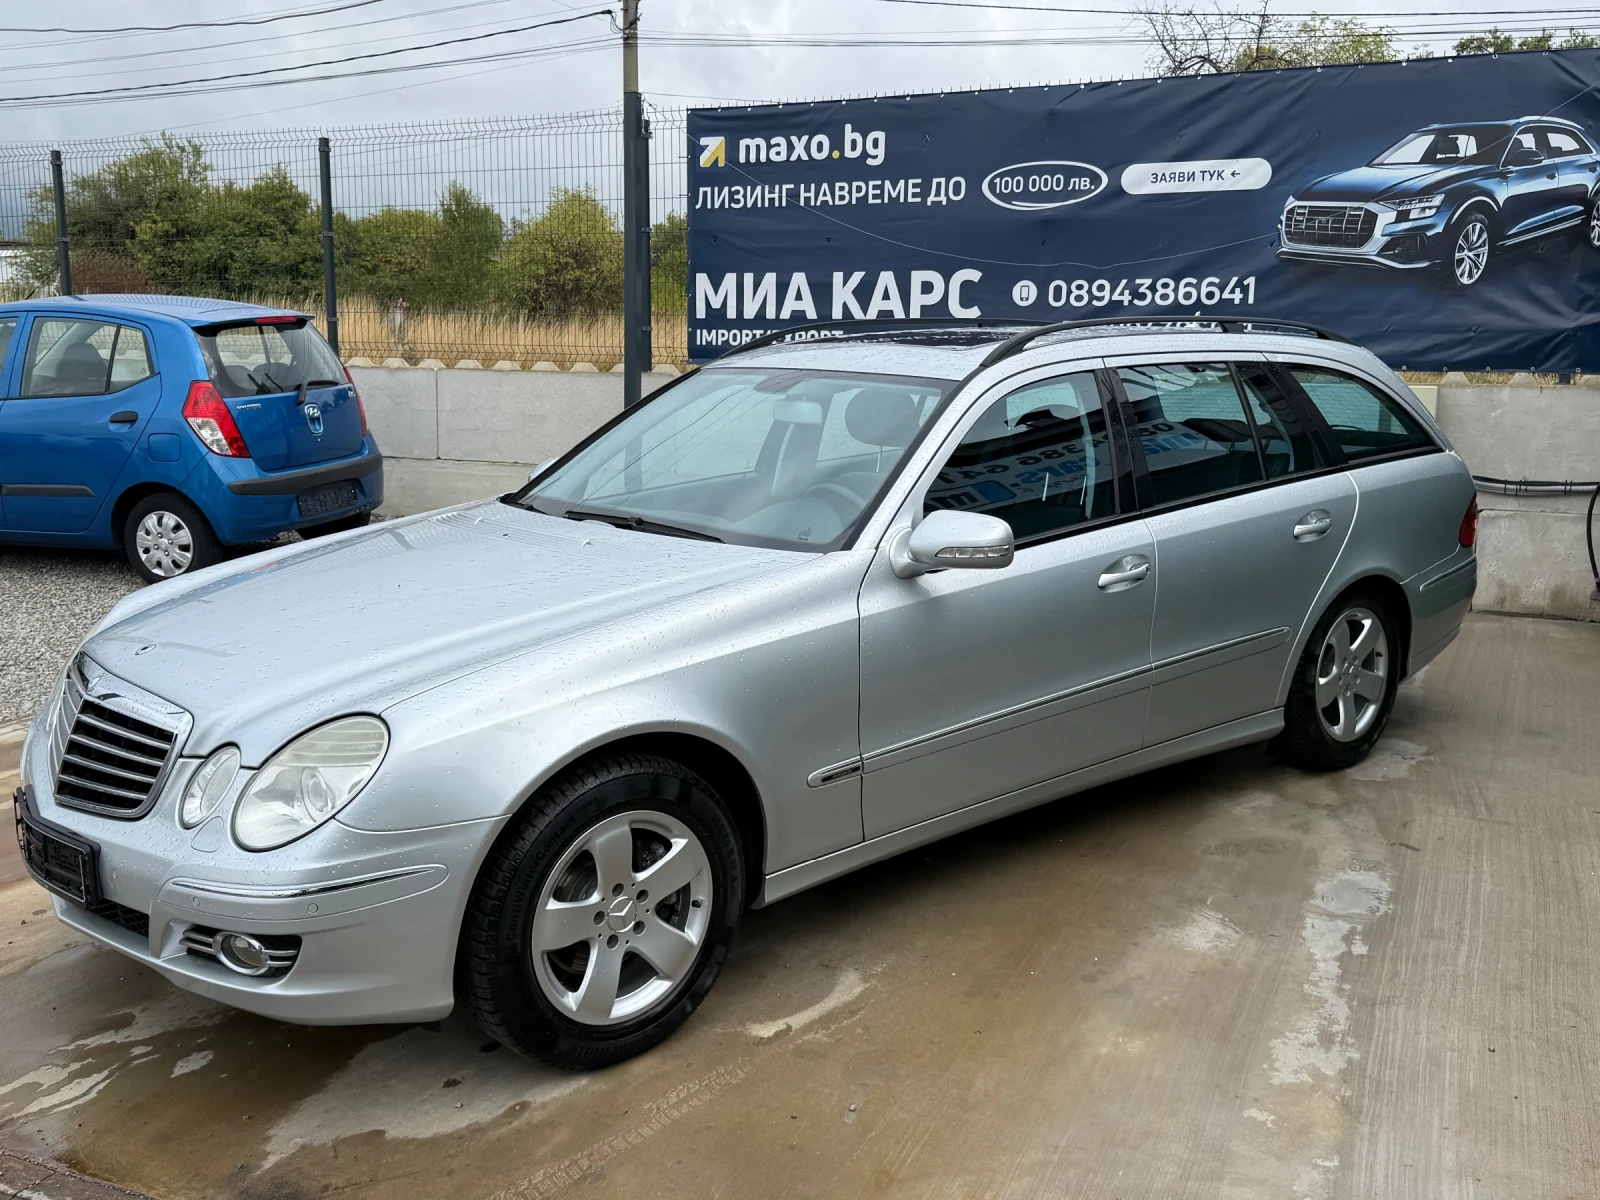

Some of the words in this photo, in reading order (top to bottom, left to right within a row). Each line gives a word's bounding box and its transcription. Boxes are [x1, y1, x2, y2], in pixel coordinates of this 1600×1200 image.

[738, 123, 886, 167] maxo.bg
[695, 184, 794, 209] ЛИЗИНГ
[800, 178, 922, 207] НАВРЕМЕ
[926, 176, 966, 206] ДО
[993, 176, 1024, 194] 100
[1028, 174, 1064, 192] 000
[1150, 171, 1196, 184] ЗАЯВИ
[1199, 169, 1225, 182] ТУК
[695, 271, 818, 320] МИА
[831, 268, 983, 320] КАРС
[1048, 276, 1256, 307] 0894386641
